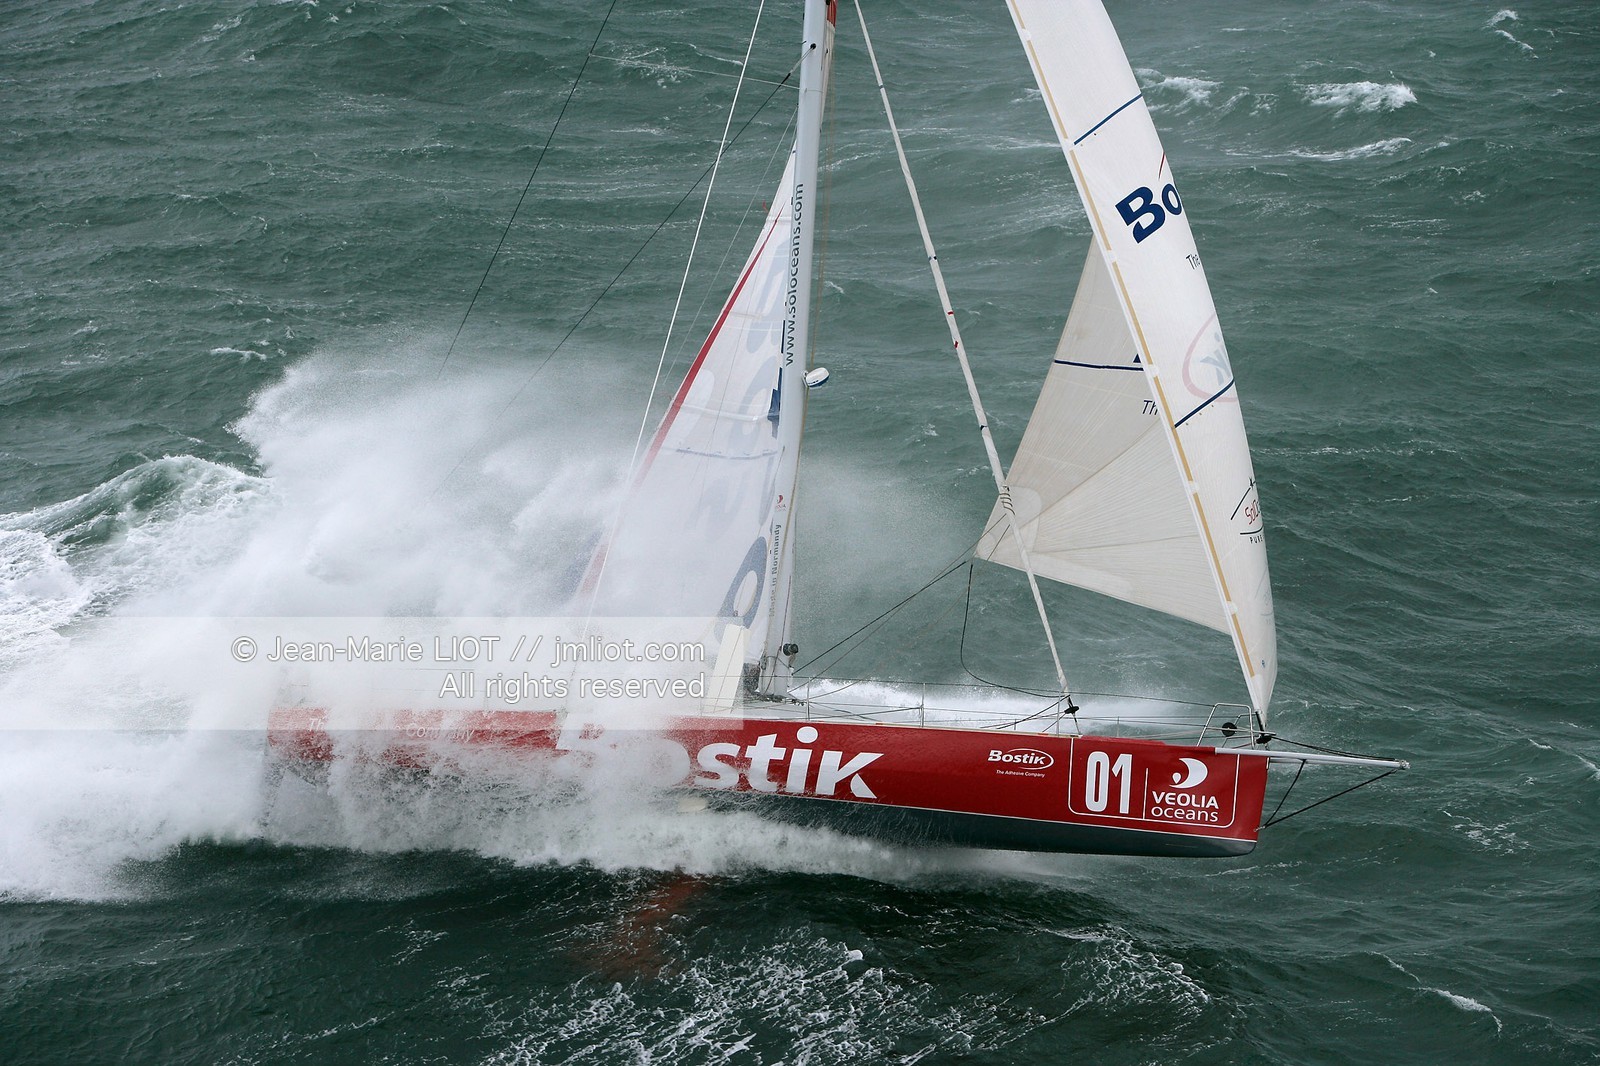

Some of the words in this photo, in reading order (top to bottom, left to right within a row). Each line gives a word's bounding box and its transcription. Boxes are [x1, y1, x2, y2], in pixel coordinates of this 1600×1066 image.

[785, 183, 804, 367] www.soloceans.com
[771, 524, 782, 575] Normandy
[988, 749, 1046, 765] Bostik
[1085, 751, 1133, 814] 01
[1151, 790, 1219, 810] VEOLIA
[1151, 805, 1219, 823] oceans
